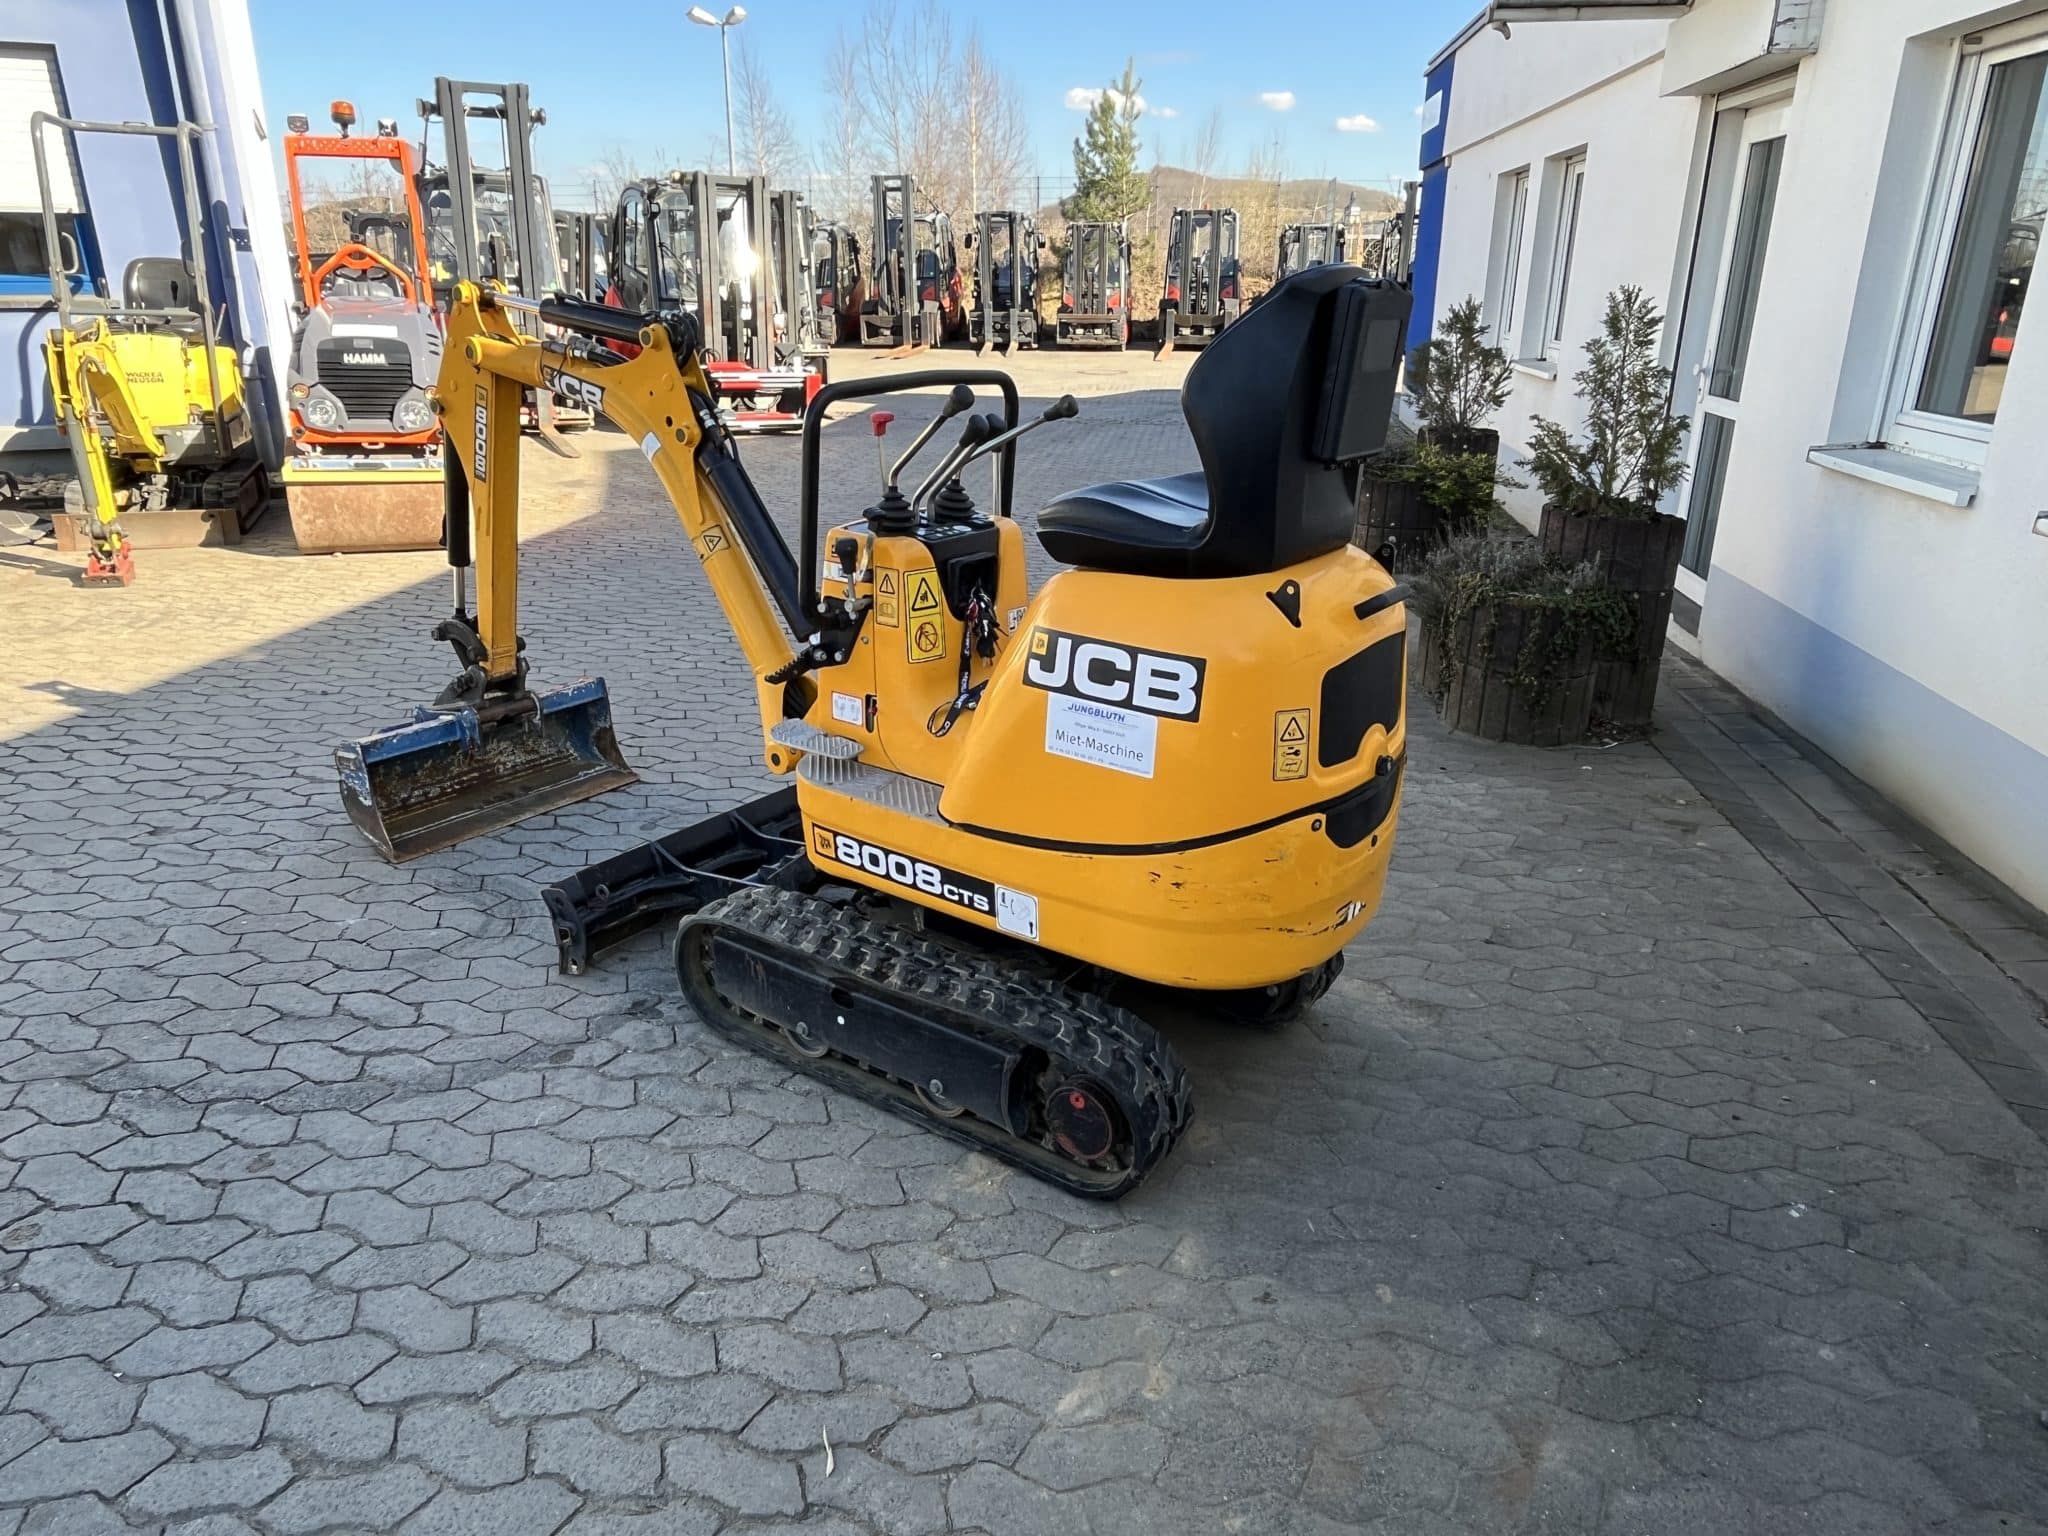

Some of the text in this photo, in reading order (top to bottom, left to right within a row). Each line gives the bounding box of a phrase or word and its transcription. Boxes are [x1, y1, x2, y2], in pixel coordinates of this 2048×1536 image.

[343, 353, 386, 365] HAMM
[544, 370, 604, 411] JCB
[1028, 637, 1198, 715] JCB
[1067, 702, 1126, 723] JUNGBLUTH
[1055, 729, 1144, 762] Miet-Maschine
